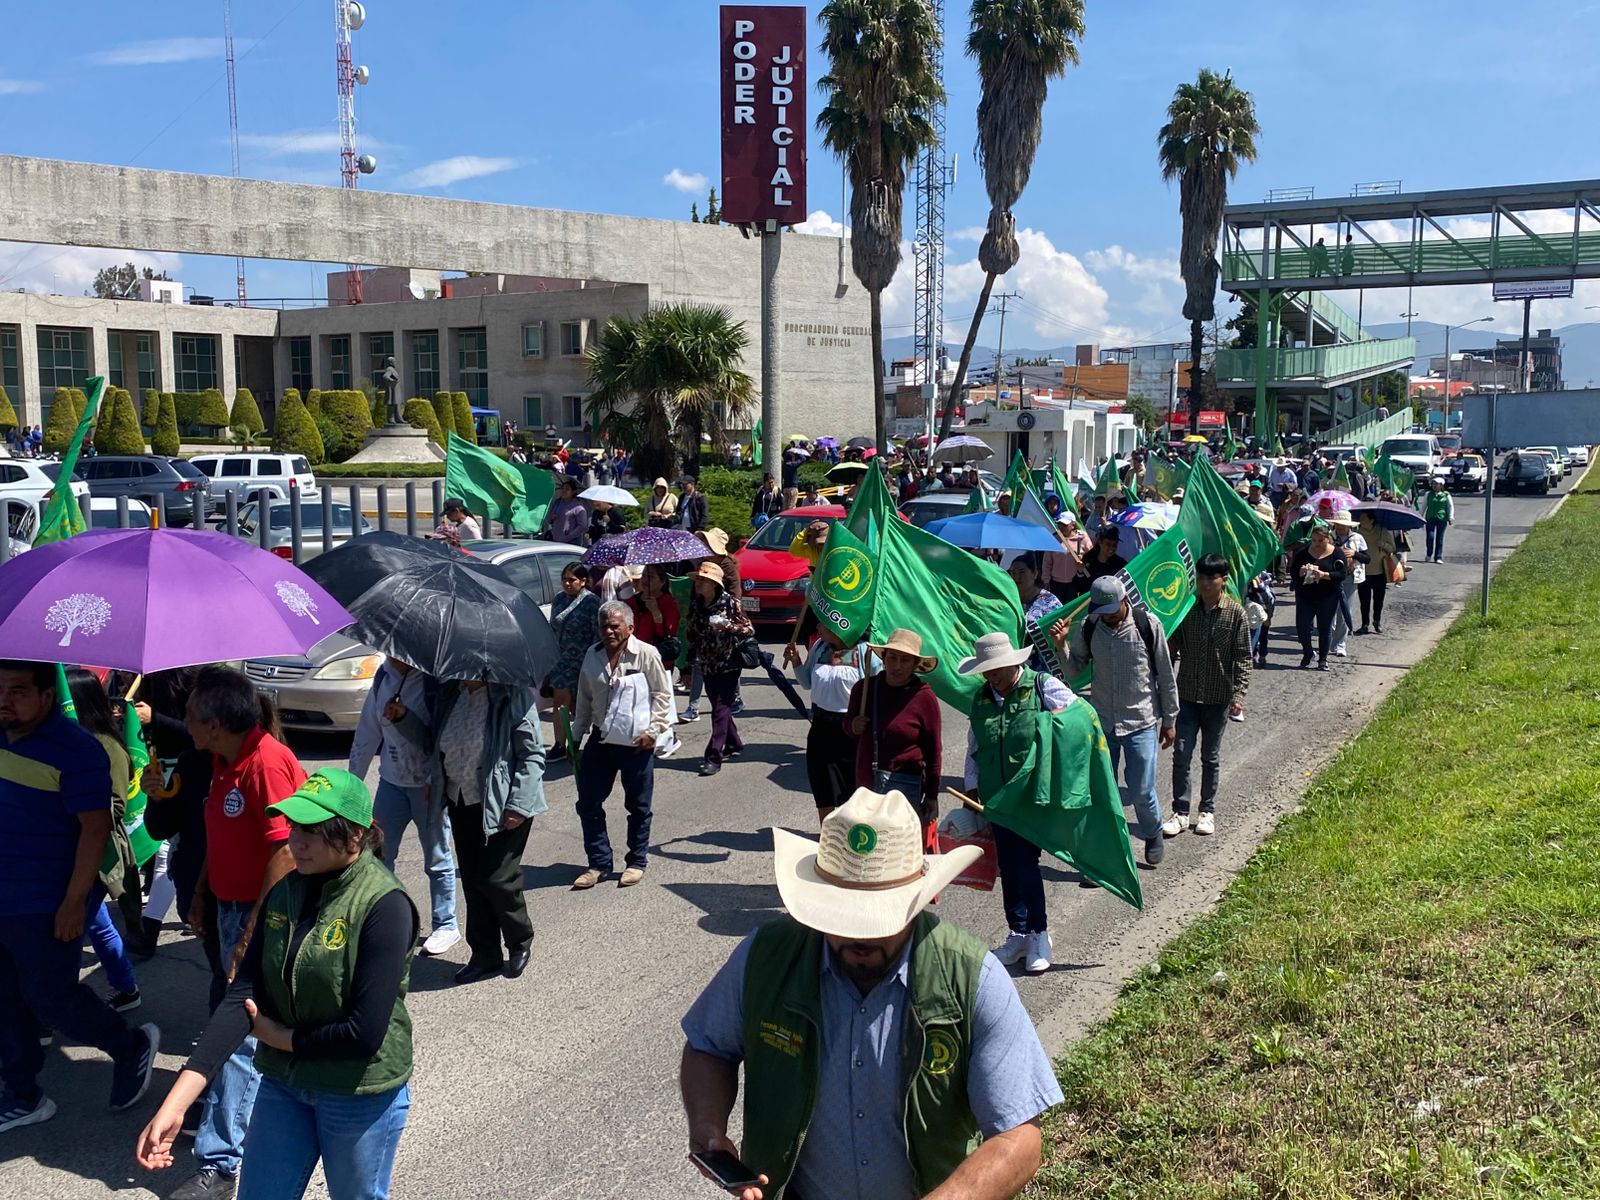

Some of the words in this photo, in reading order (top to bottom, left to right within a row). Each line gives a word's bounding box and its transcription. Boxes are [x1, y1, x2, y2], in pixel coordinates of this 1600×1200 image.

[733, 20, 757, 124] PODER
[770, 46, 794, 206] JUDICIAL
[784, 323, 839, 334] PROCURADURIA
[842, 326, 872, 336] GENERAL
[807, 336, 816, 346] DE
[819, 337, 851, 347] JUSTICIA
